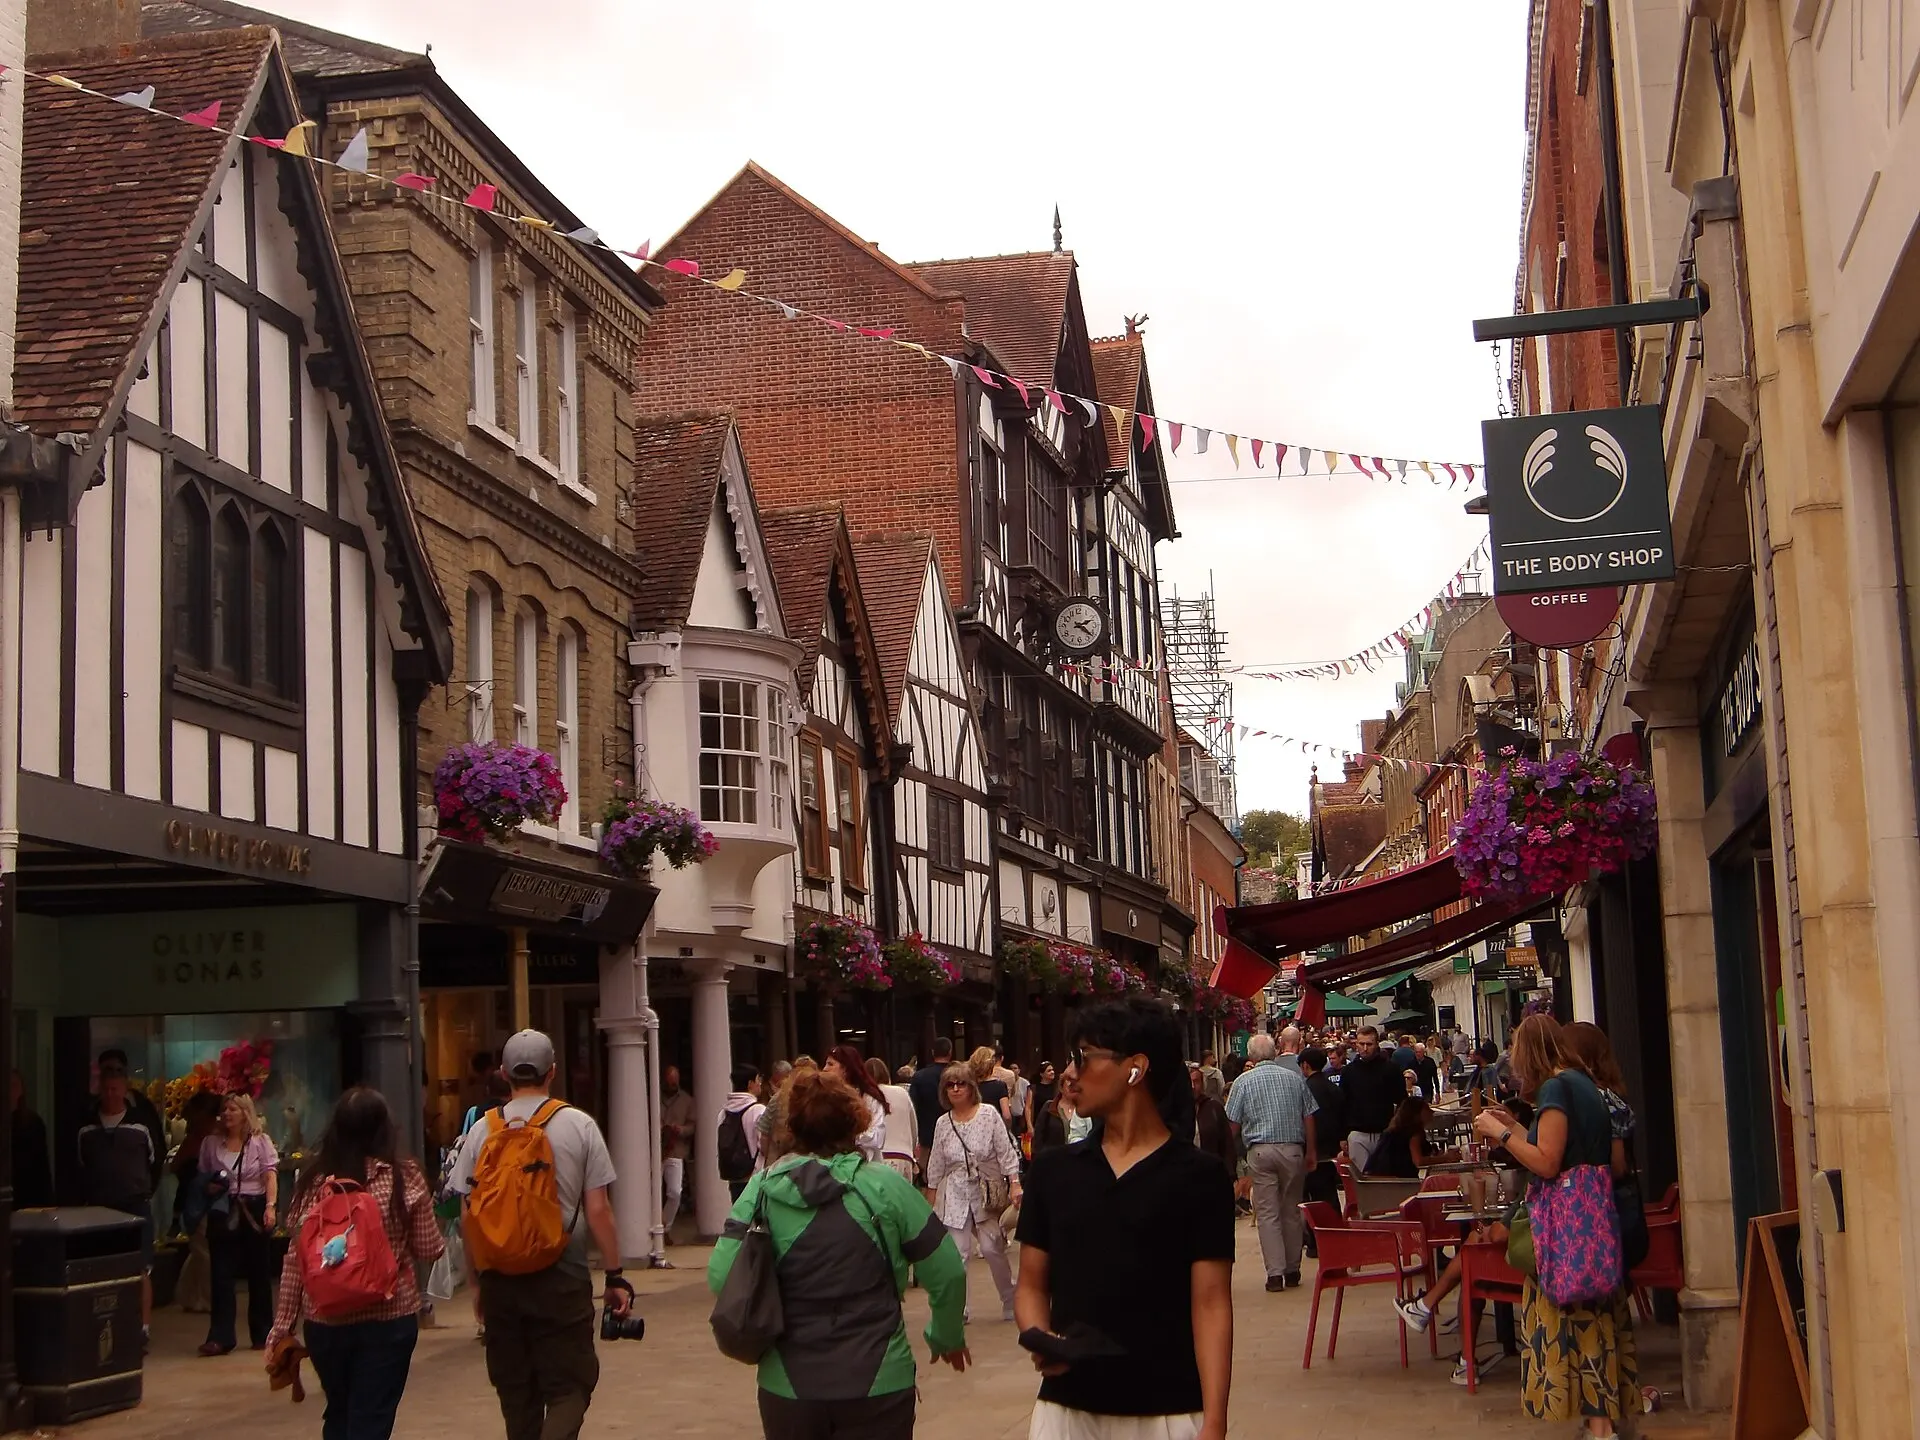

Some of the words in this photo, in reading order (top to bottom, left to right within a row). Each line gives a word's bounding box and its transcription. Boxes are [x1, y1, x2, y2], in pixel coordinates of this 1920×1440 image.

[1502, 558, 1542, 577] THE
[1549, 552, 1603, 573] BODY
[1608, 547, 1663, 568] SHOP
[1531, 593, 1588, 606] COFFEE
[1720, 679, 1737, 760] THE
[1733, 640, 1755, 737] BODY
[153, 929, 266, 957] OLIVER
[155, 957, 264, 985] BONAS
